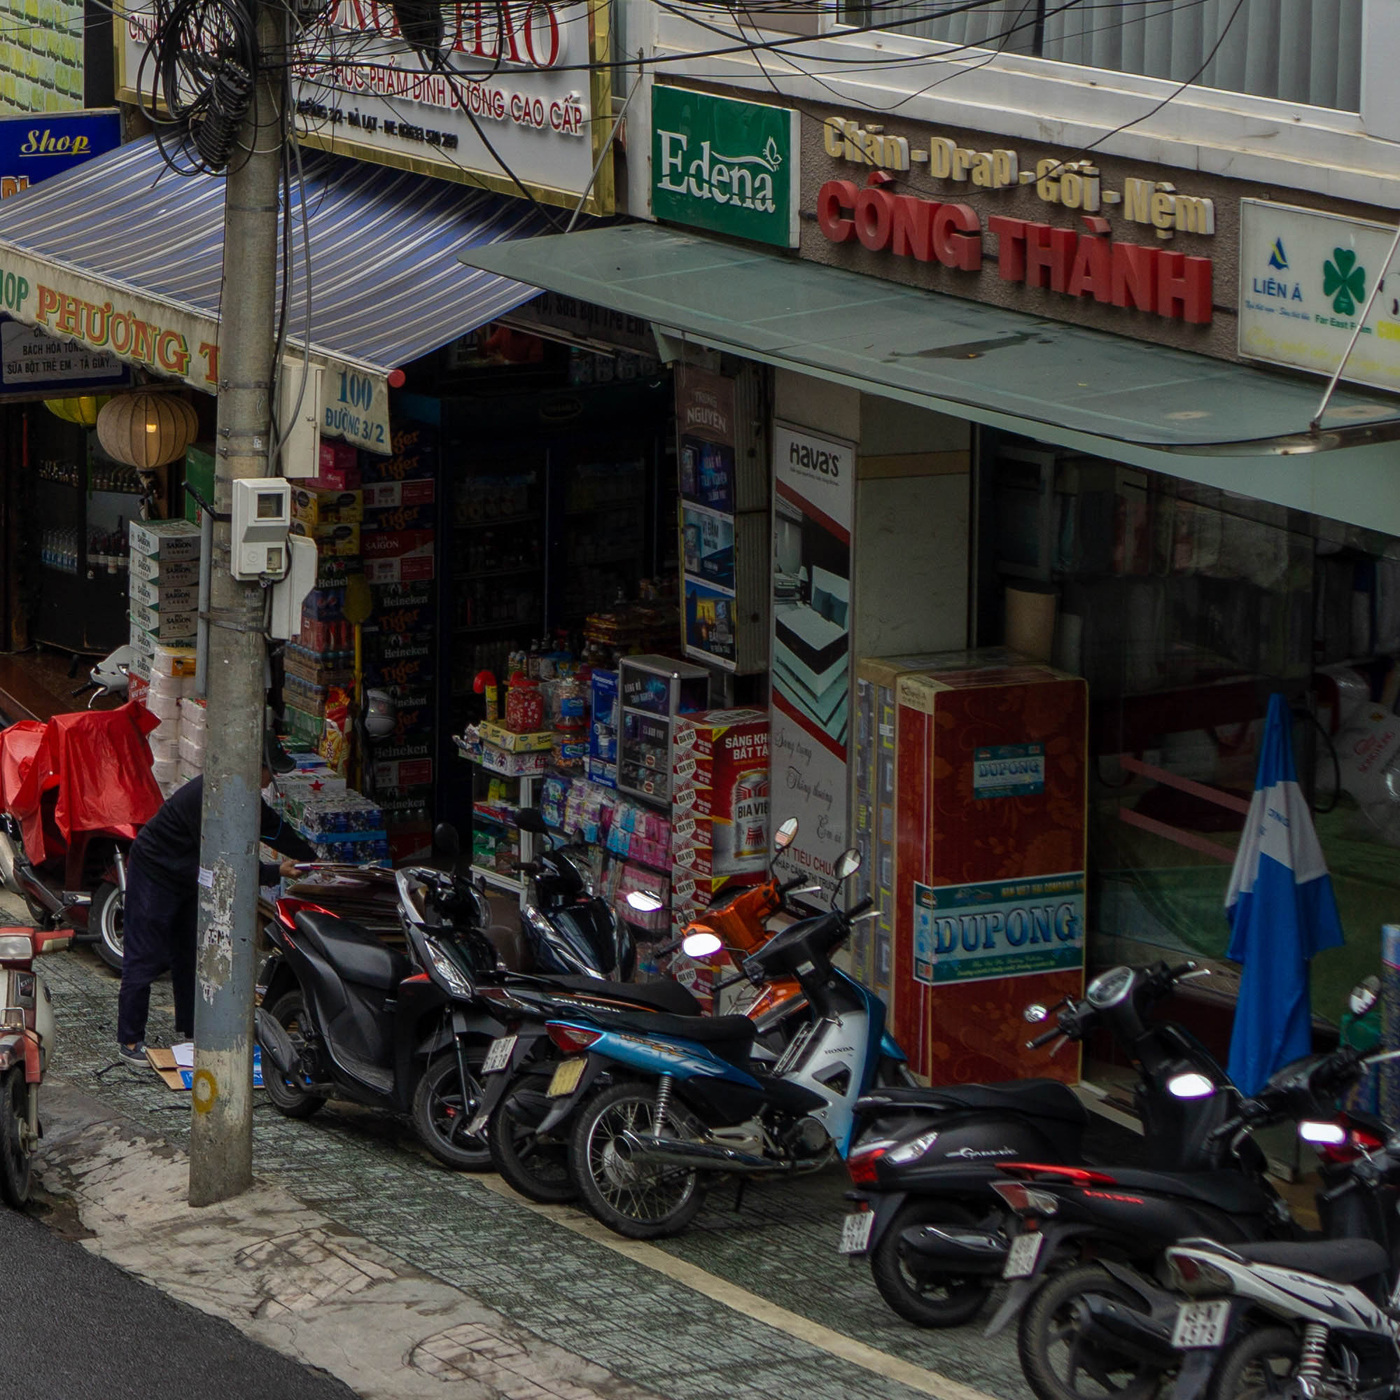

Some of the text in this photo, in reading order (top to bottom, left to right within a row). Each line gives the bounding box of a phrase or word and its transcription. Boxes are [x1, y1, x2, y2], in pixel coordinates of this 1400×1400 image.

[510, 92, 545, 127] CAO
[548, 89, 585, 135] CẤP
[19, 128, 91, 156] Shop
[657, 127, 777, 215] Edena
[929, 135, 1019, 190] Drap
[1034, 156, 1101, 213] Gối
[1122, 176, 1216, 240] Nệm
[816, 170, 1214, 325] CÔNG THÀNH
[1252, 277, 1303, 303] LIÊN Á
[35, 284, 192, 376] PHƯƠNG
[1314, 314, 1349, 330] Far East
[22, 343, 44, 357] BÁCH
[7, 359, 23, 375] SỮA
[25, 359, 41, 374] BỘT
[59, 358, 72, 371] EM
[336, 370, 374, 410] 100
[324, 407, 359, 434] ĐƯỜNG
[378, 507, 420, 532] Tiger
[166, 538, 192, 550] SAIGON
[364, 539, 399, 551] SAIGON
[374, 744, 429, 757] Heineken
[978, 760, 1041, 779] DUPONG
[737, 802, 751, 818] BIA
[934, 901, 1077, 956] DUPONG
[824, 1046, 855, 1056] HONDA
